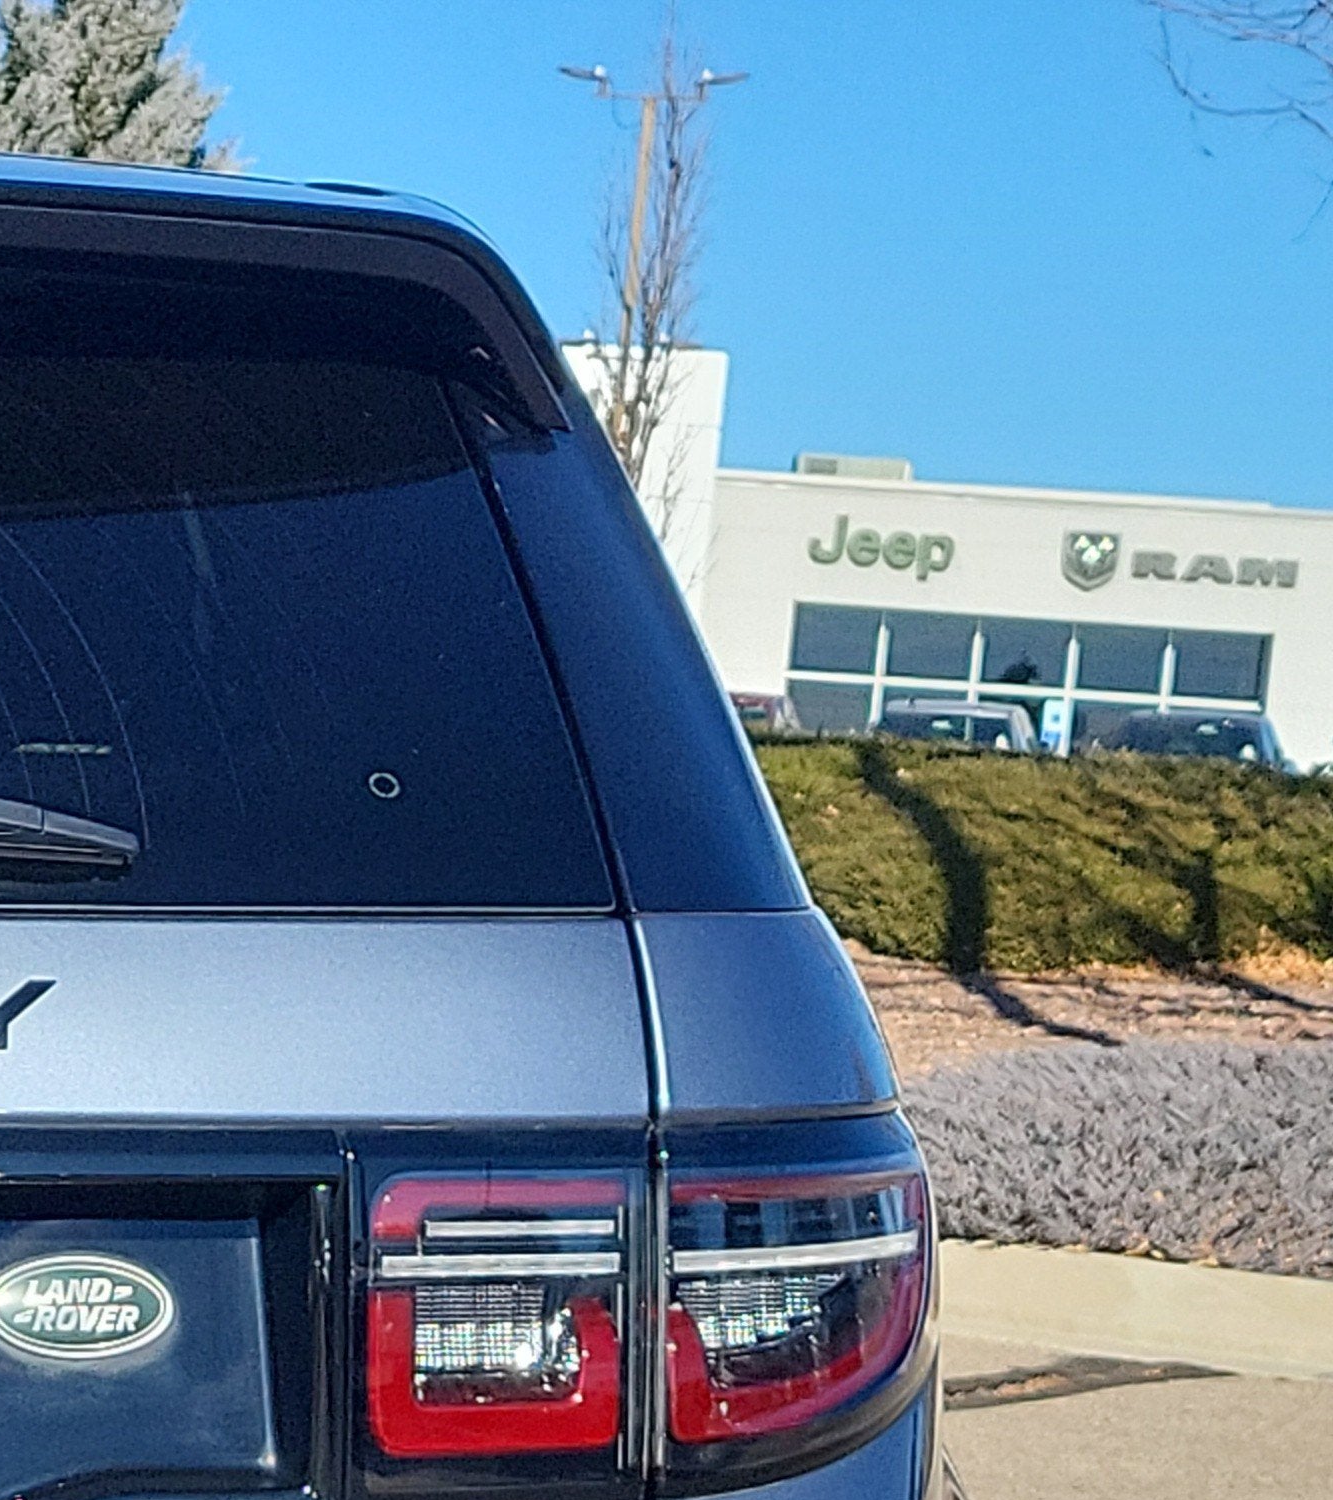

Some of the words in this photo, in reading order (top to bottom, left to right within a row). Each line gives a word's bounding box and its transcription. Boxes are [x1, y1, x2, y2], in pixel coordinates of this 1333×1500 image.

[808, 514, 954, 581] Jeep
[1131, 550, 1299, 589] RAM
[21, 1277, 114, 1306] LAND
[31, 1304, 141, 1333] ROVER
